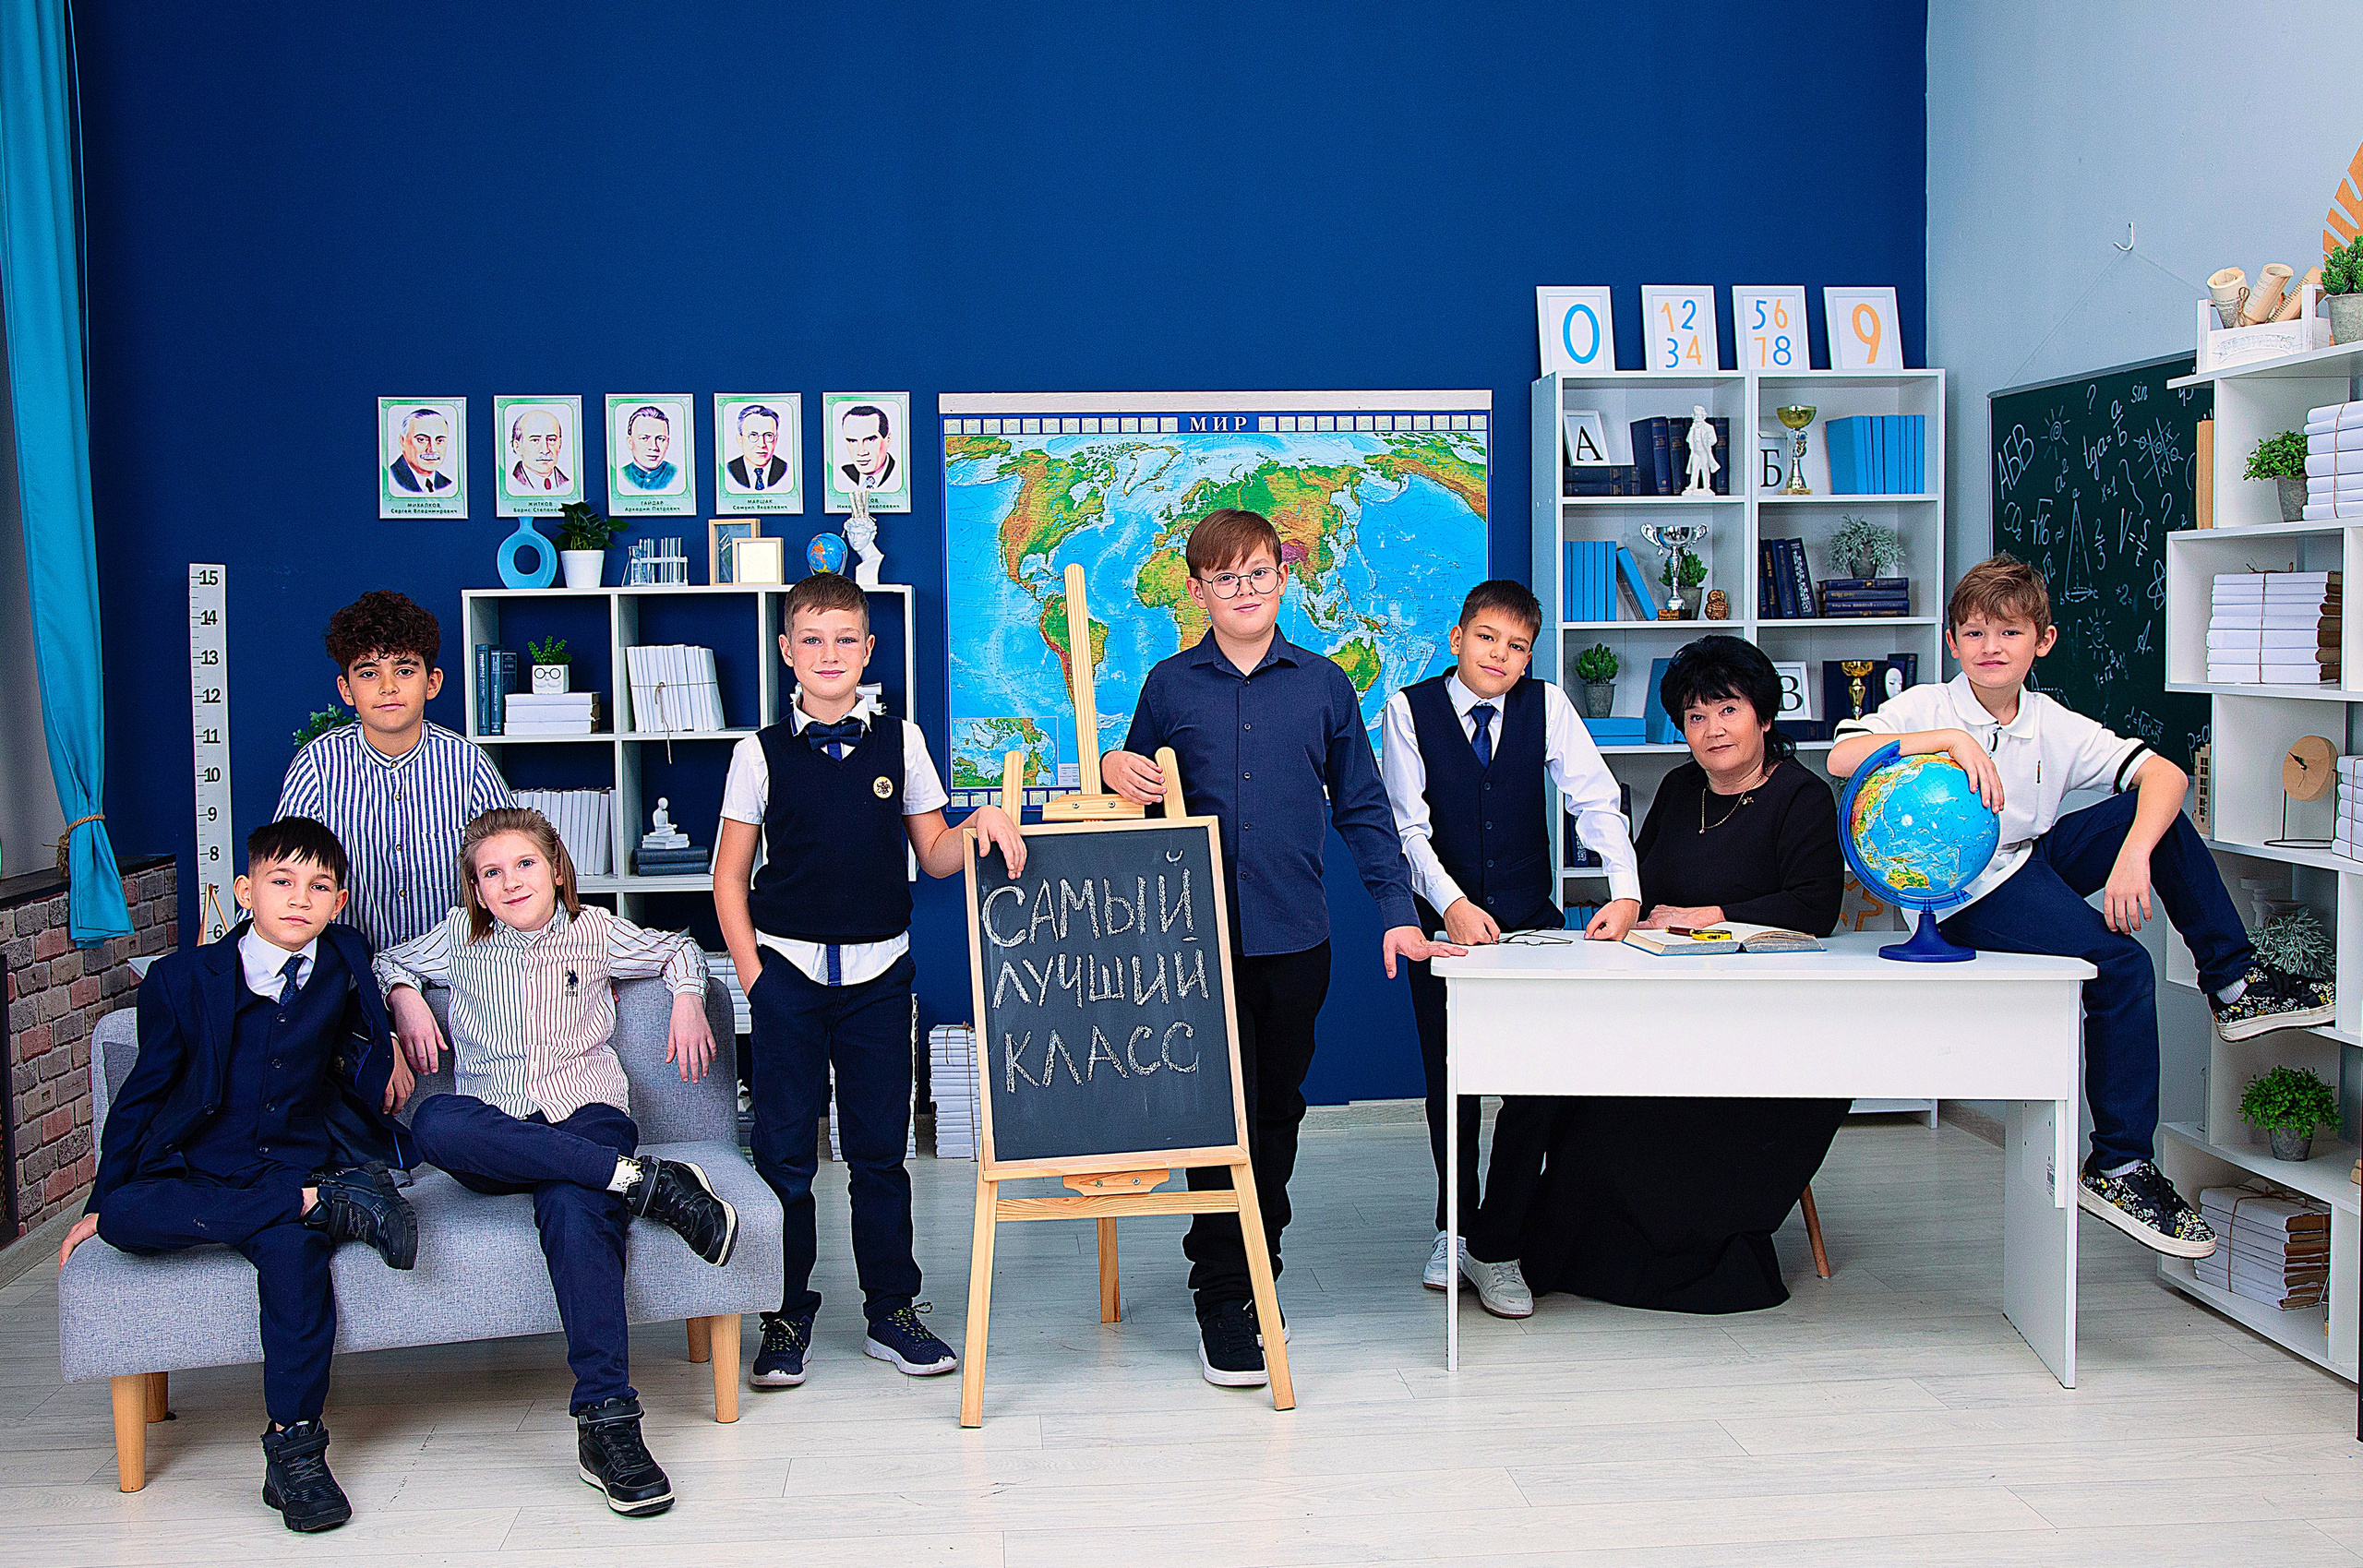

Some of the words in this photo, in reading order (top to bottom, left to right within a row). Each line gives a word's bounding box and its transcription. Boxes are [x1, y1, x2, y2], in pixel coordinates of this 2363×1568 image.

[1852, 303, 1881, 365] 9
[1189, 416, 1248, 432] МИР
[1759, 449, 1783, 487] Б
[1997, 424, 2035, 499] АБВ
[199, 569, 219, 586] 15
[200, 609, 218, 626] 14
[200, 649, 219, 665] 13
[202, 688, 221, 704] 12
[202, 728, 221, 744] 11
[204, 767, 222, 783] 10
[207, 806, 218, 822] 9
[209, 845, 220, 862] 8
[981, 848, 1195, 949] САМЫЙ
[212, 924, 223, 940] 6
[1004, 1020, 1199, 1094] КЛАСС
